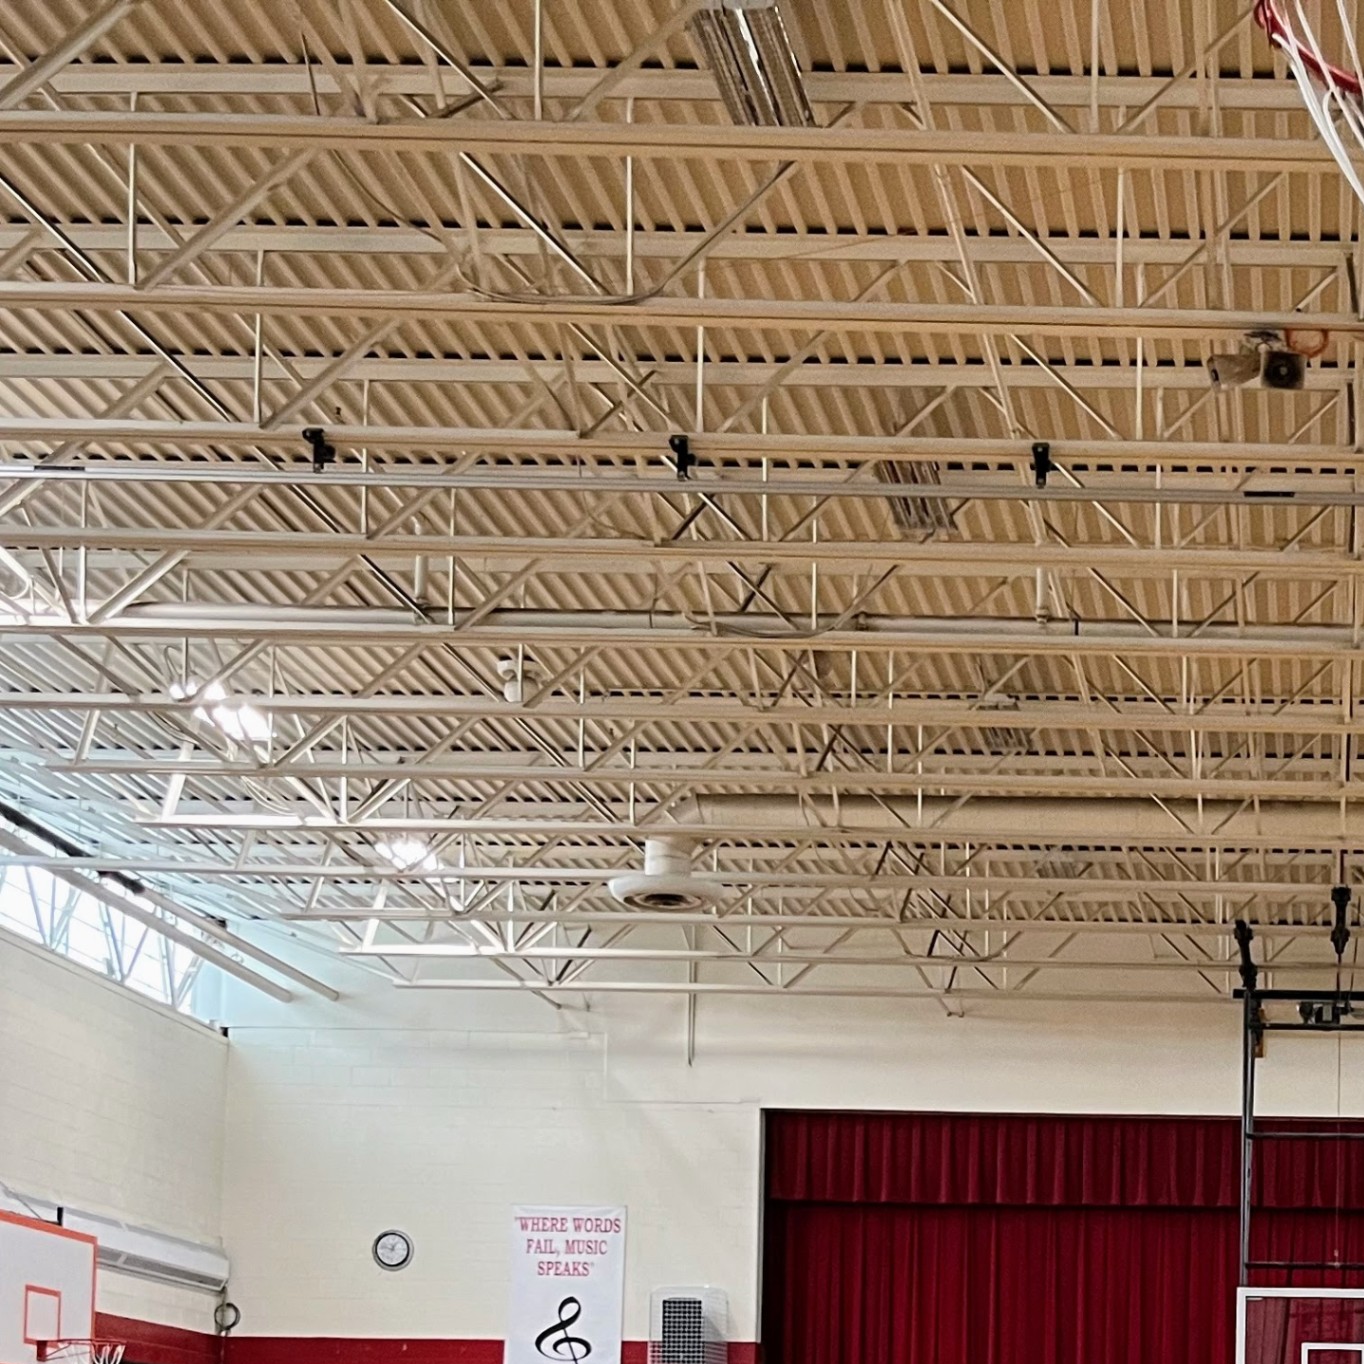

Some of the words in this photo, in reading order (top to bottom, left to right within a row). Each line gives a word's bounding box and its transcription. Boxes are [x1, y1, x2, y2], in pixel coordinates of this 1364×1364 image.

[572, 1217, 622, 1234] WORDS
[526, 1238, 560, 1257] FAIL,
[565, 1239, 608, 1255] MUSIC
